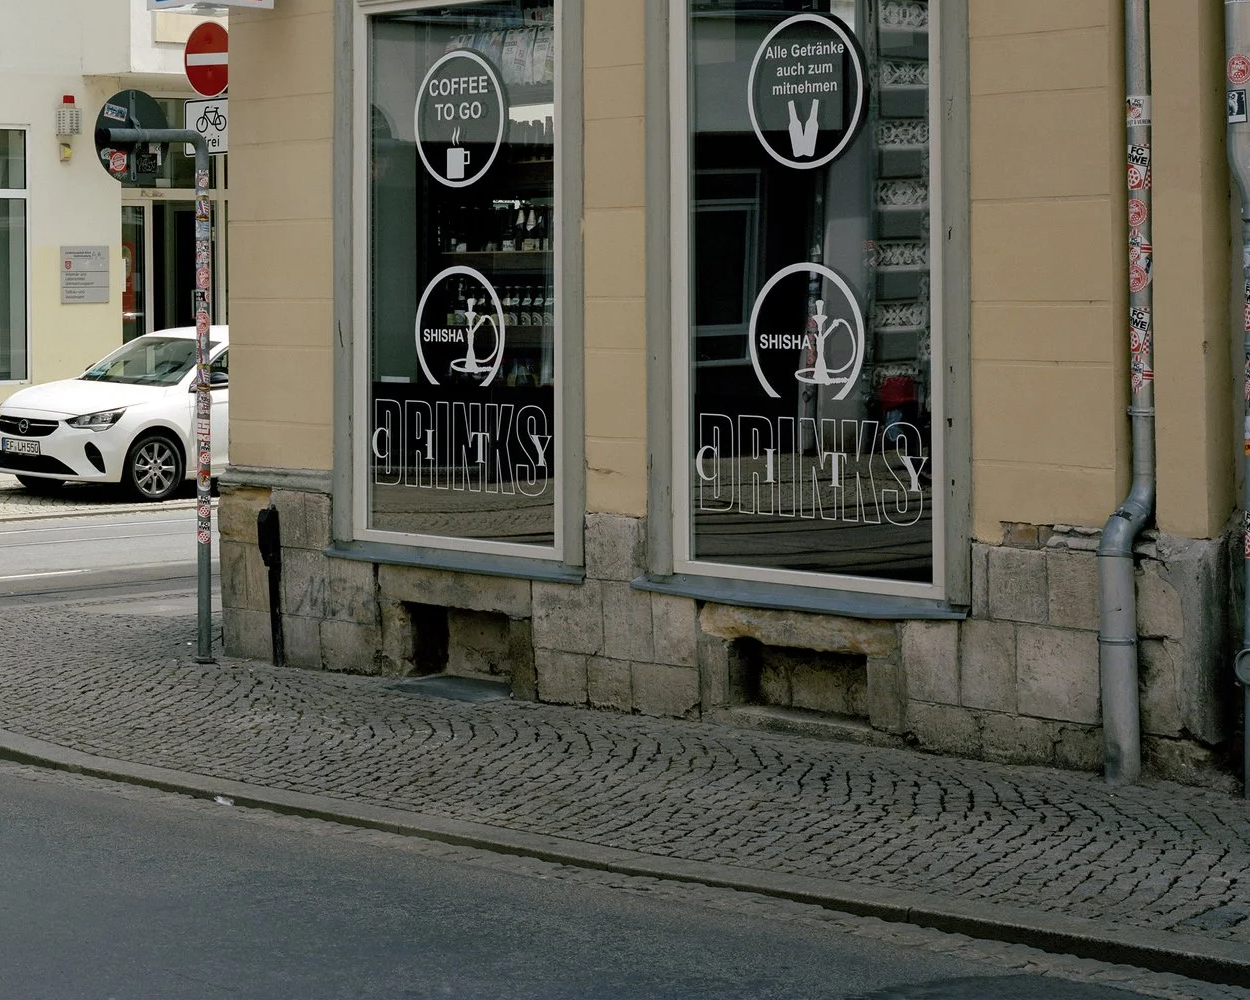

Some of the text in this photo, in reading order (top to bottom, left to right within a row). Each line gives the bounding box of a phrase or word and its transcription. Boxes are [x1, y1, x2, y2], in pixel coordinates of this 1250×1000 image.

[765, 41, 844, 59] Alle Getränke
[777, 62, 833, 77] auch zum
[429, 75, 488, 97] COFFEE
[772, 80, 838, 95] mitnehmen
[434, 101, 482, 120] TO GO
[1131, 147, 1144, 155] FC
[1132, 310, 1145, 319] FC
[423, 328, 465, 343] SHISHA
[759, 333, 812, 350] SHISHA
[6, 440, 39, 454] EF LH 550
[374, 398, 548, 497] DRINKS
[699, 412, 924, 527] DRINKS
